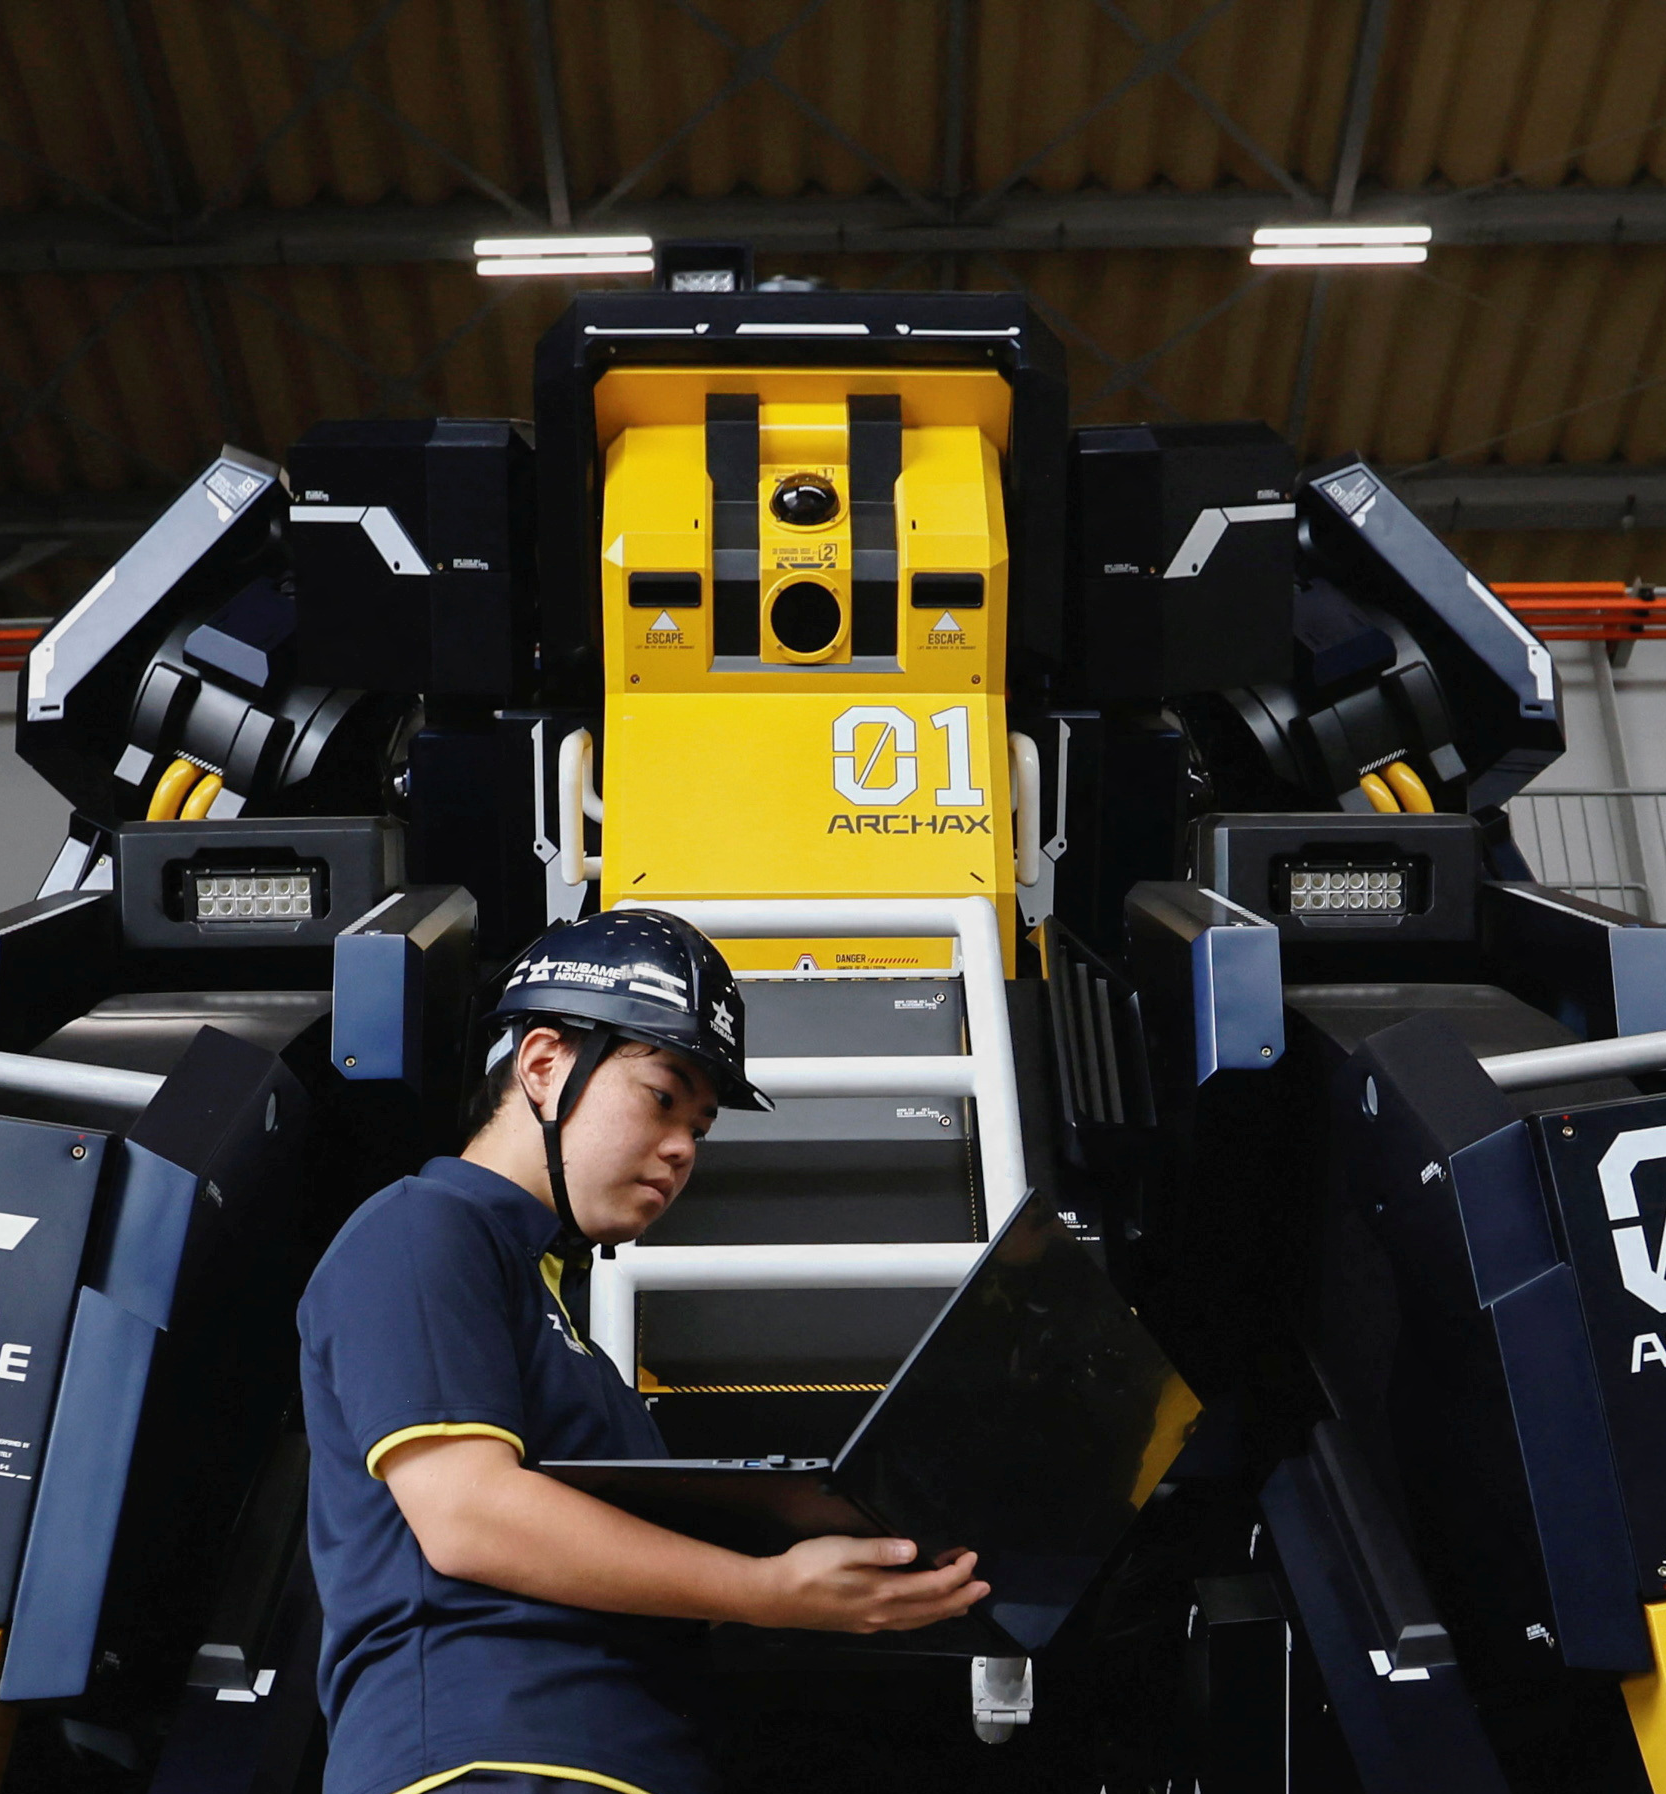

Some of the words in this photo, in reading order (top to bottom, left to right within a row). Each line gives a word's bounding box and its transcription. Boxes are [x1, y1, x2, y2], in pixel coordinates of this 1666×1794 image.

[823, 546, 833, 561] 2
[646, 633, 684, 644] ESCAPE
[928, 634, 966, 645] ESCAPE
[833, 706, 984, 806] 01
[827, 815, 992, 834] ARCHAX
[836, 954, 866, 963] DANGER
[556, 960, 624, 980] TSUBAME
[554, 972, 616, 988] INDUSTRIES
[709, 1020, 737, 1047] TSUBAME
